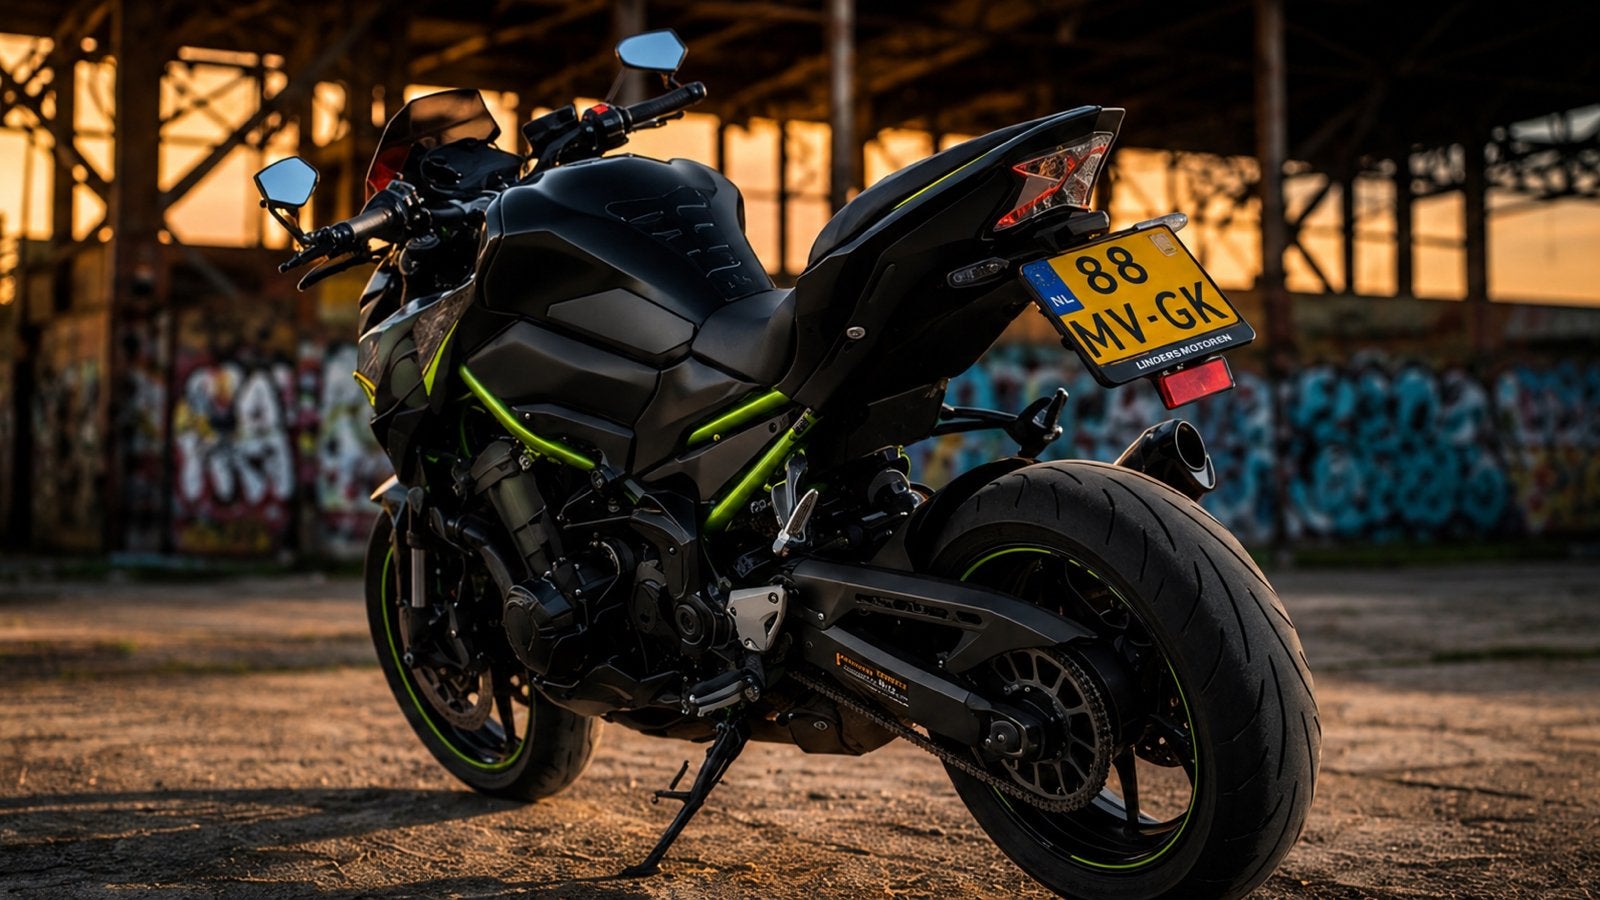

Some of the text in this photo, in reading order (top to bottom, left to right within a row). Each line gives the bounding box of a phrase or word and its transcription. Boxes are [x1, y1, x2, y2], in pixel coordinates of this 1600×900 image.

[1075, 246, 1148, 294] 88
[1050, 294, 1075, 307] NL
[1069, 281, 1228, 358] MV-GK
[1135, 333, 1233, 370] LINDERS MOTOREN
